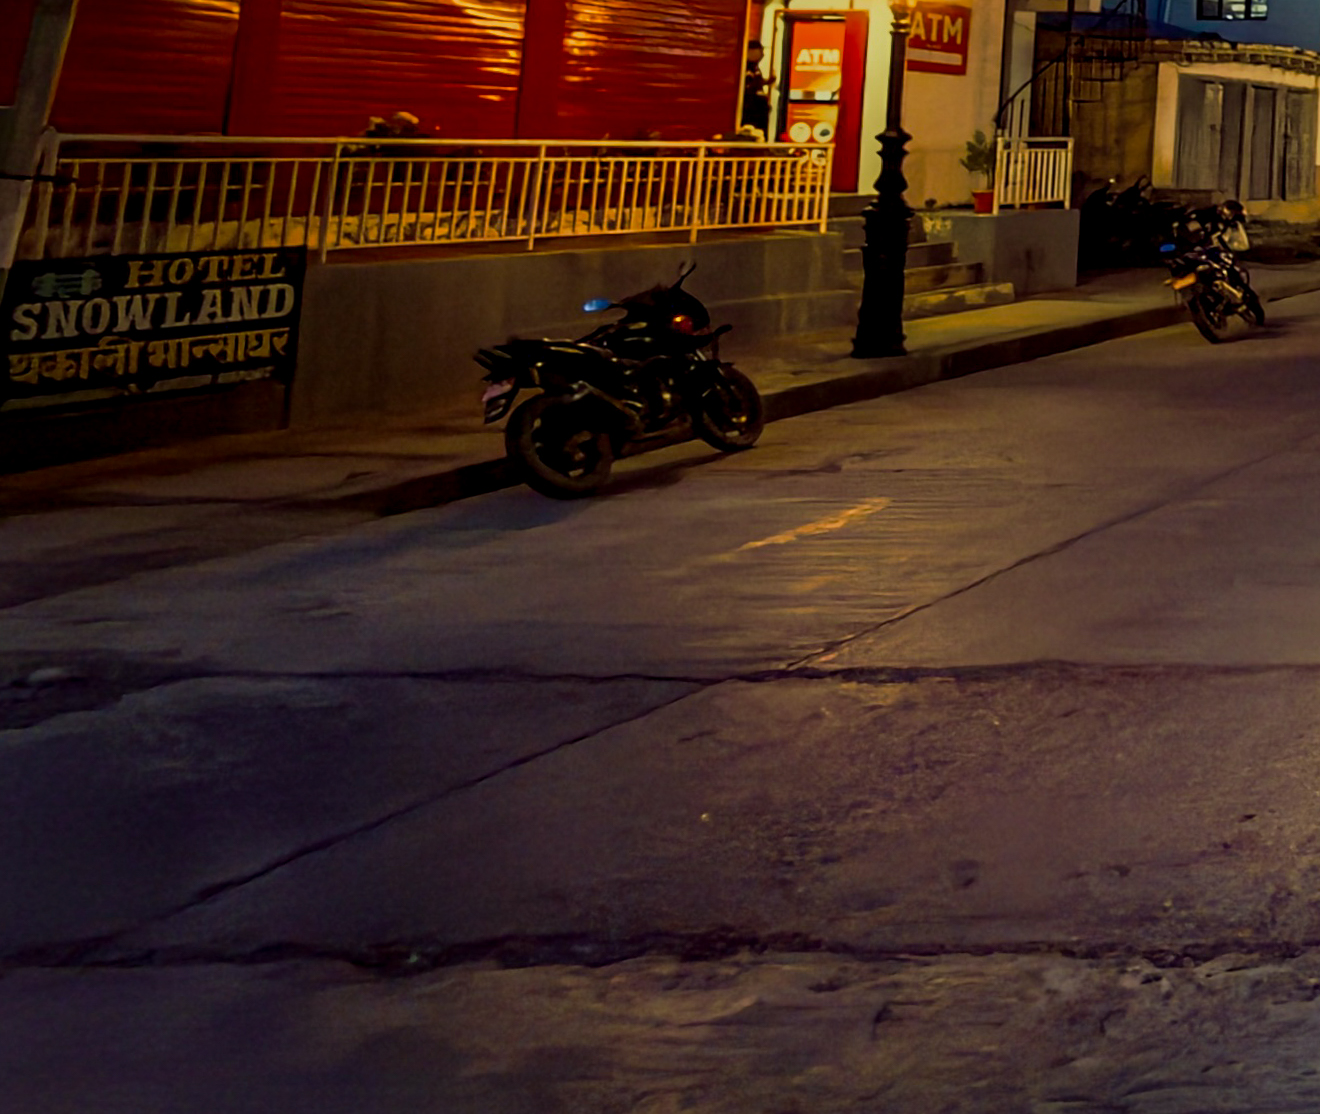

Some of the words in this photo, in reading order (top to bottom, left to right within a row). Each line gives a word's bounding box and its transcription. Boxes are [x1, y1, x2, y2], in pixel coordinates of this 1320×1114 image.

[910, 10, 964, 45] ATM
[796, 48, 840, 64] ATM
[124, 253, 286, 288] HOTEL
[10, 283, 295, 341] SNOWLAND
